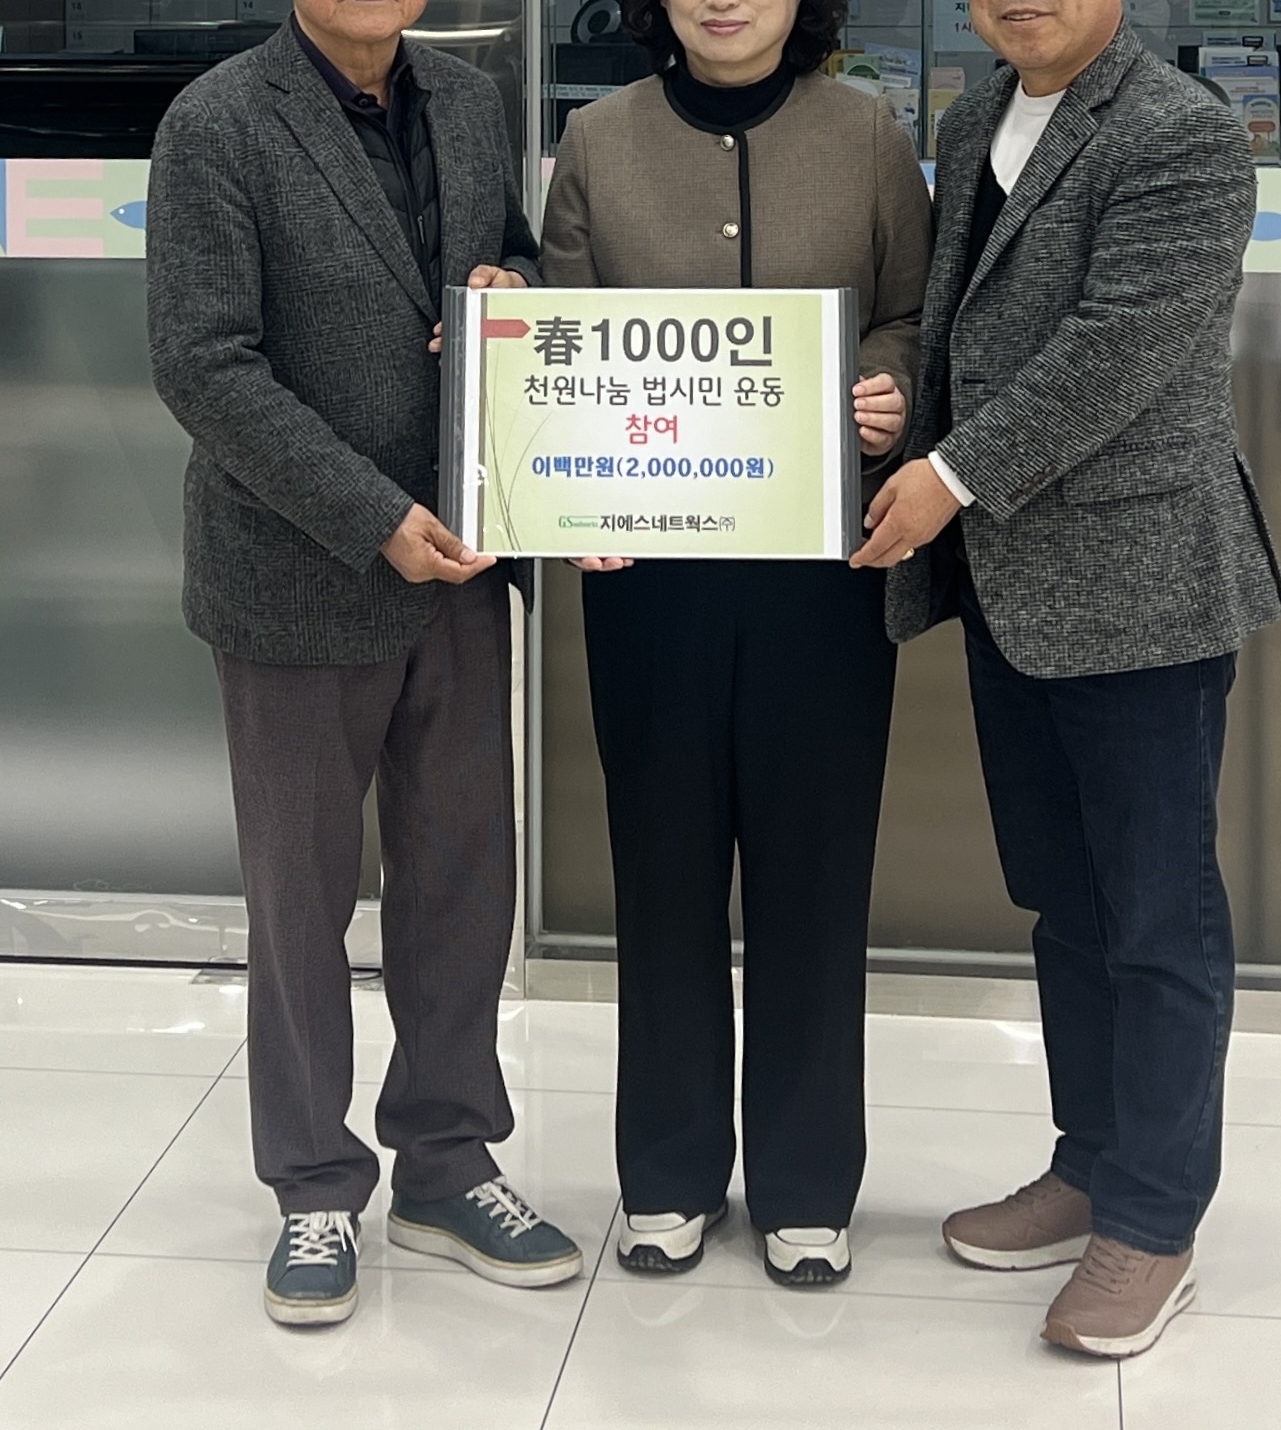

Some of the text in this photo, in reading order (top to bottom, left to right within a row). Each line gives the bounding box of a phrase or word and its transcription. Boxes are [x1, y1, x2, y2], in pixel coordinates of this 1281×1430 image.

[524, 374, 785, 407] 천원나눔 법시민 운동
[625, 413, 678, 445] 참여
[532, 456, 774, 479] 이백만원(2,000,000원)
